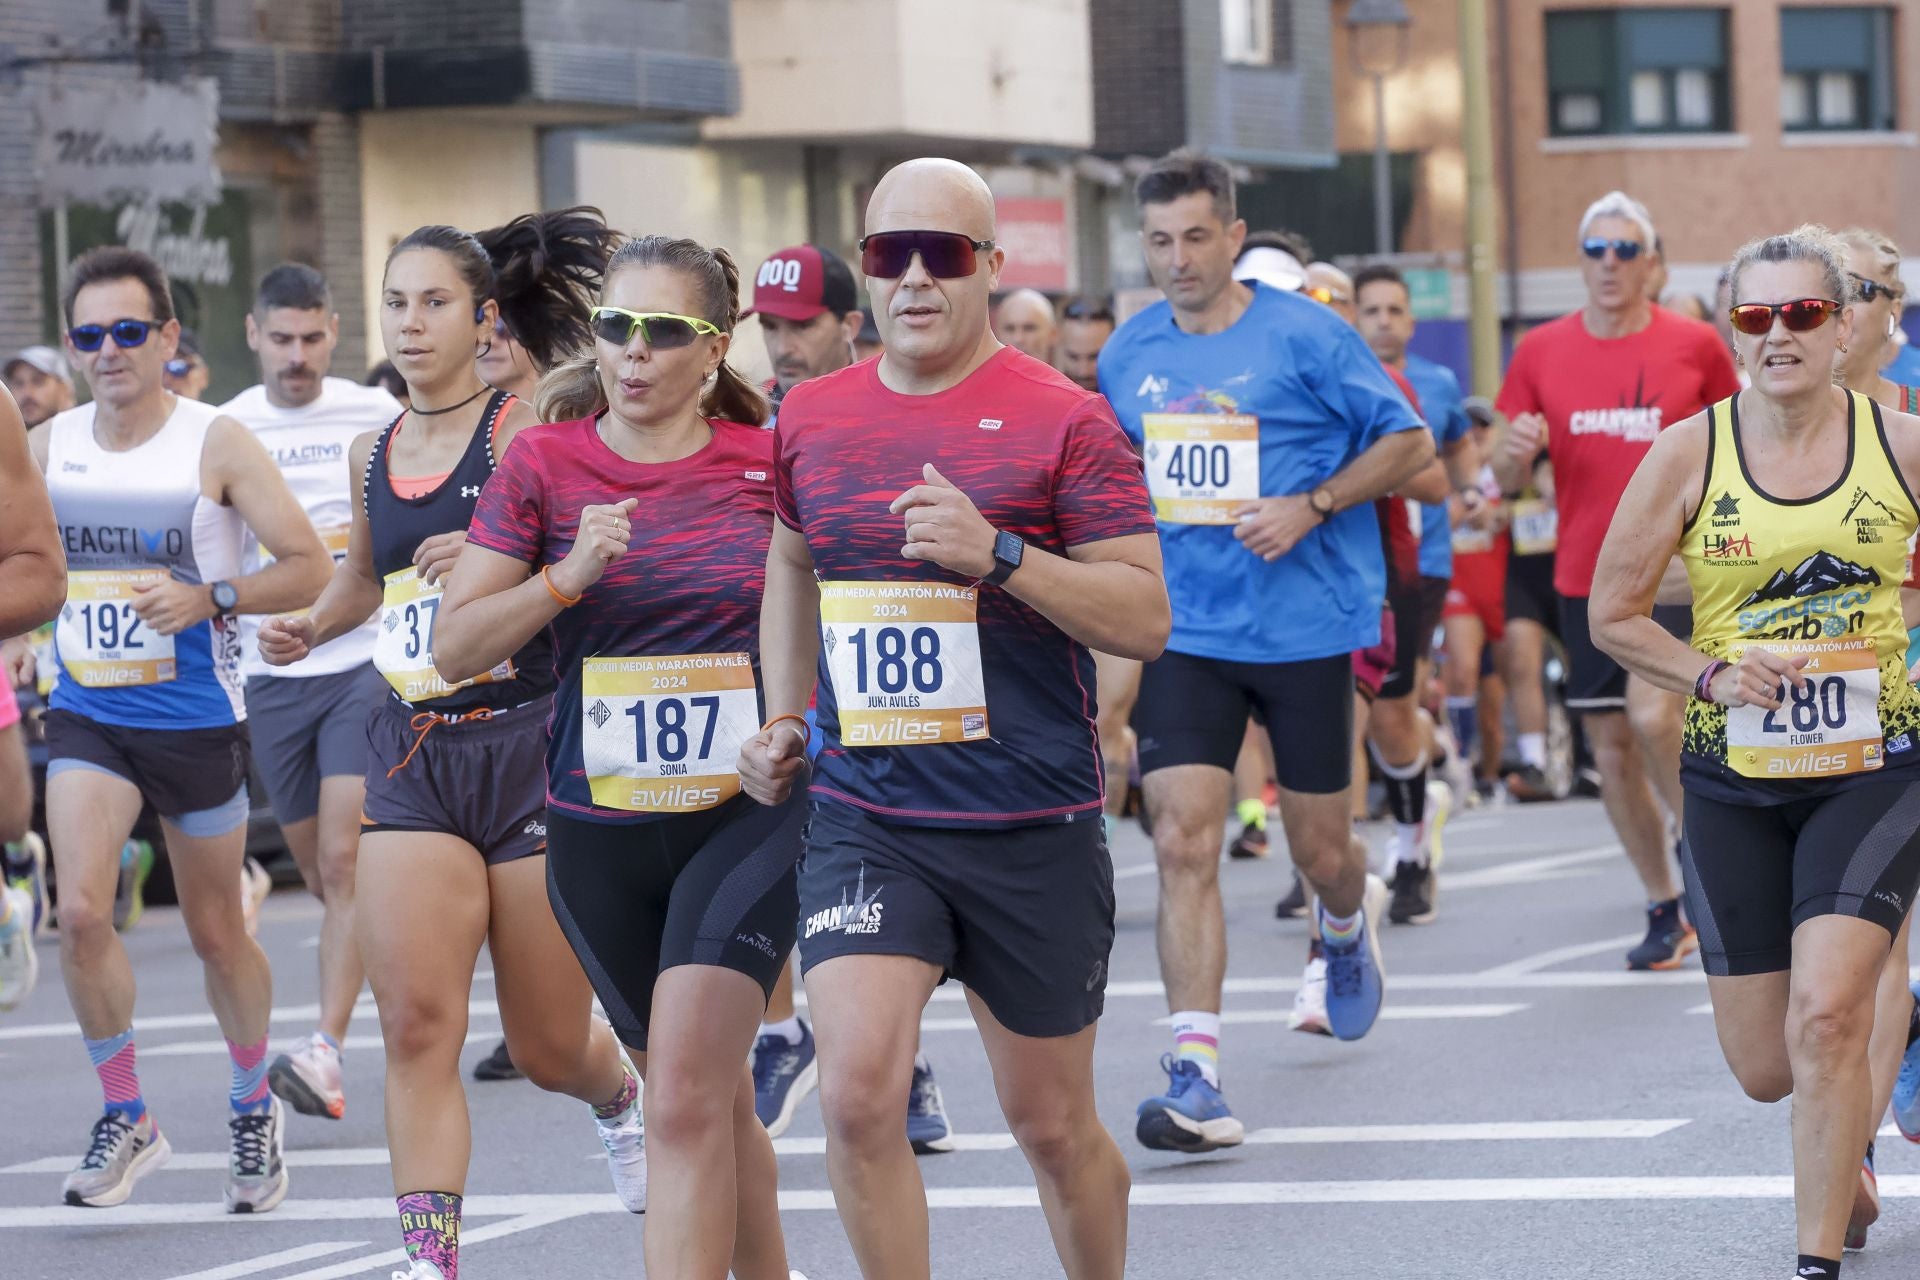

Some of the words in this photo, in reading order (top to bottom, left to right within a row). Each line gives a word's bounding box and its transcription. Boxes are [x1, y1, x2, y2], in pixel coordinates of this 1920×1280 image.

[1167, 444, 1229, 487] 400
[1712, 518, 1740, 527] luanvi
[845, 587, 876, 598] MEDIA
[879, 585, 932, 599] MARATÓN
[935, 588, 974, 601] AVILÉS
[872, 604, 908, 617] 2024
[81, 603, 144, 649] 192
[1791, 640, 1843, 653] MARATÓN
[621, 661, 654, 673] MEDIA
[656, 656, 712, 671] MARATÓN
[715, 654, 749, 668] AVILÉS
[848, 626, 943, 694] 188
[651, 676, 687, 689] 2024
[867, 695, 887, 708] JUKI
[889, 693, 920, 708] AVILÉS
[1762, 676, 1847, 733] 280
[625, 695, 720, 763] 187
[850, 717, 943, 742] avilés
[1790, 732, 1824, 745] FLOWER
[660, 763, 687, 776] SONIA
[1767, 751, 1848, 774] avilés
[630, 784, 721, 807] avilés
[804, 902, 884, 939] CHANWAS
[844, 922, 881, 935] AVILES
